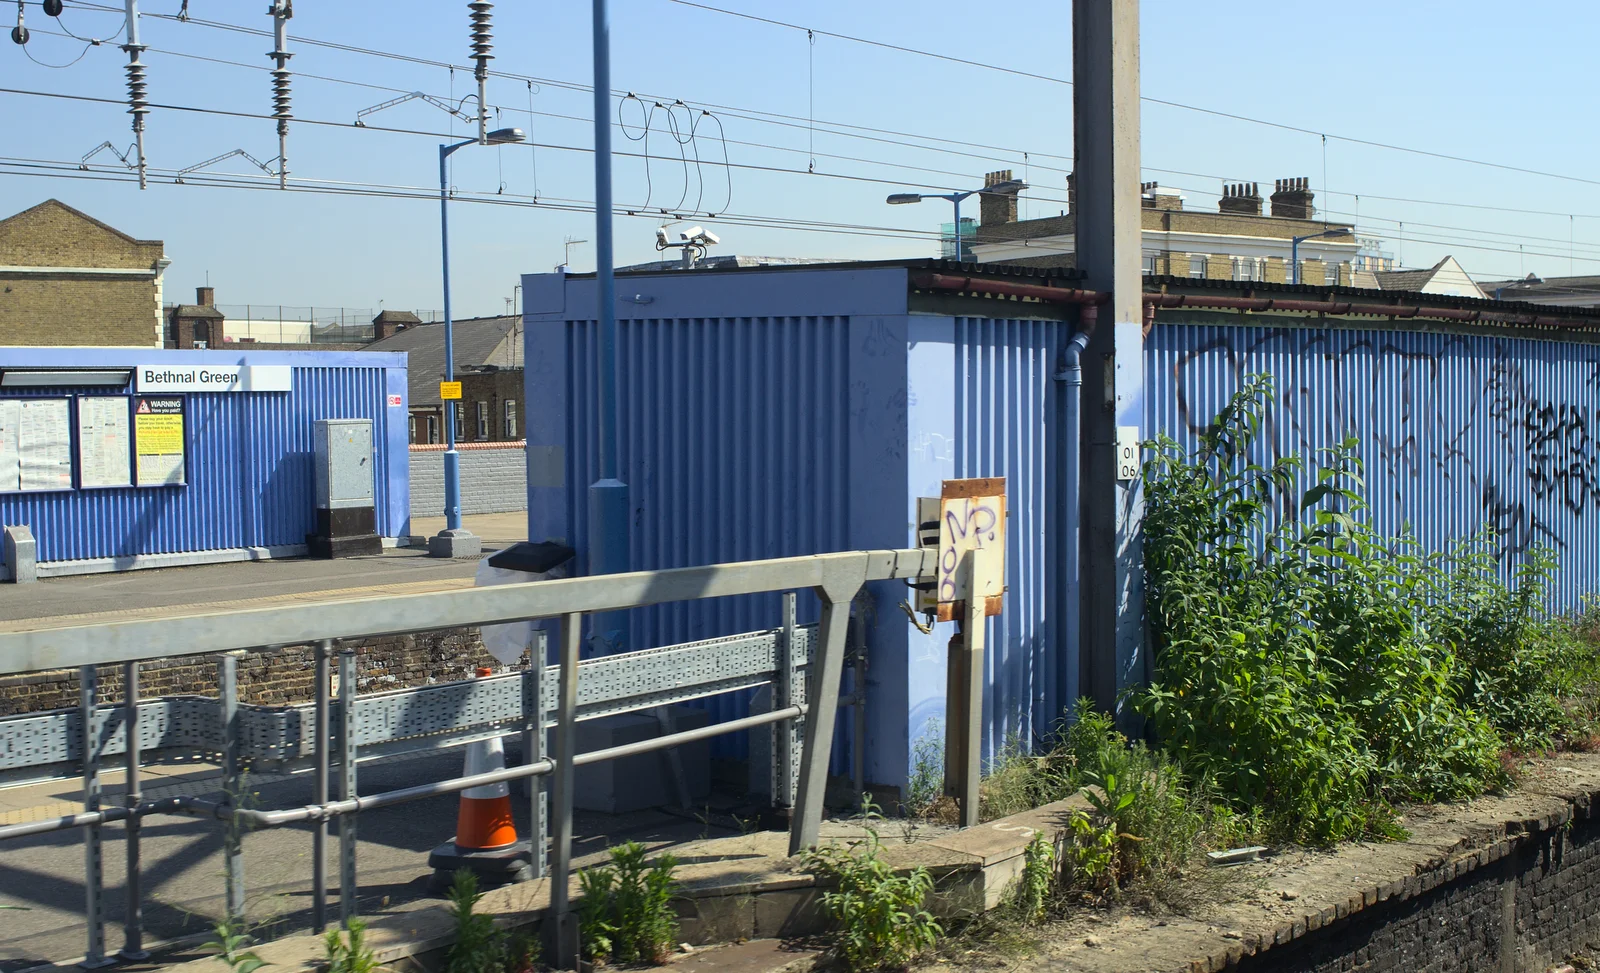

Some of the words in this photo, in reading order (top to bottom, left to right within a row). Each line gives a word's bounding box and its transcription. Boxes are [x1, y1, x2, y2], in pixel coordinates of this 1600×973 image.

[145, 370, 195, 383] Bethnal
[199, 370, 238, 383] Green
[150, 400, 181, 408] WARNING
[1123, 447, 1134, 459] 01
[1122, 465, 1136, 477] 06
